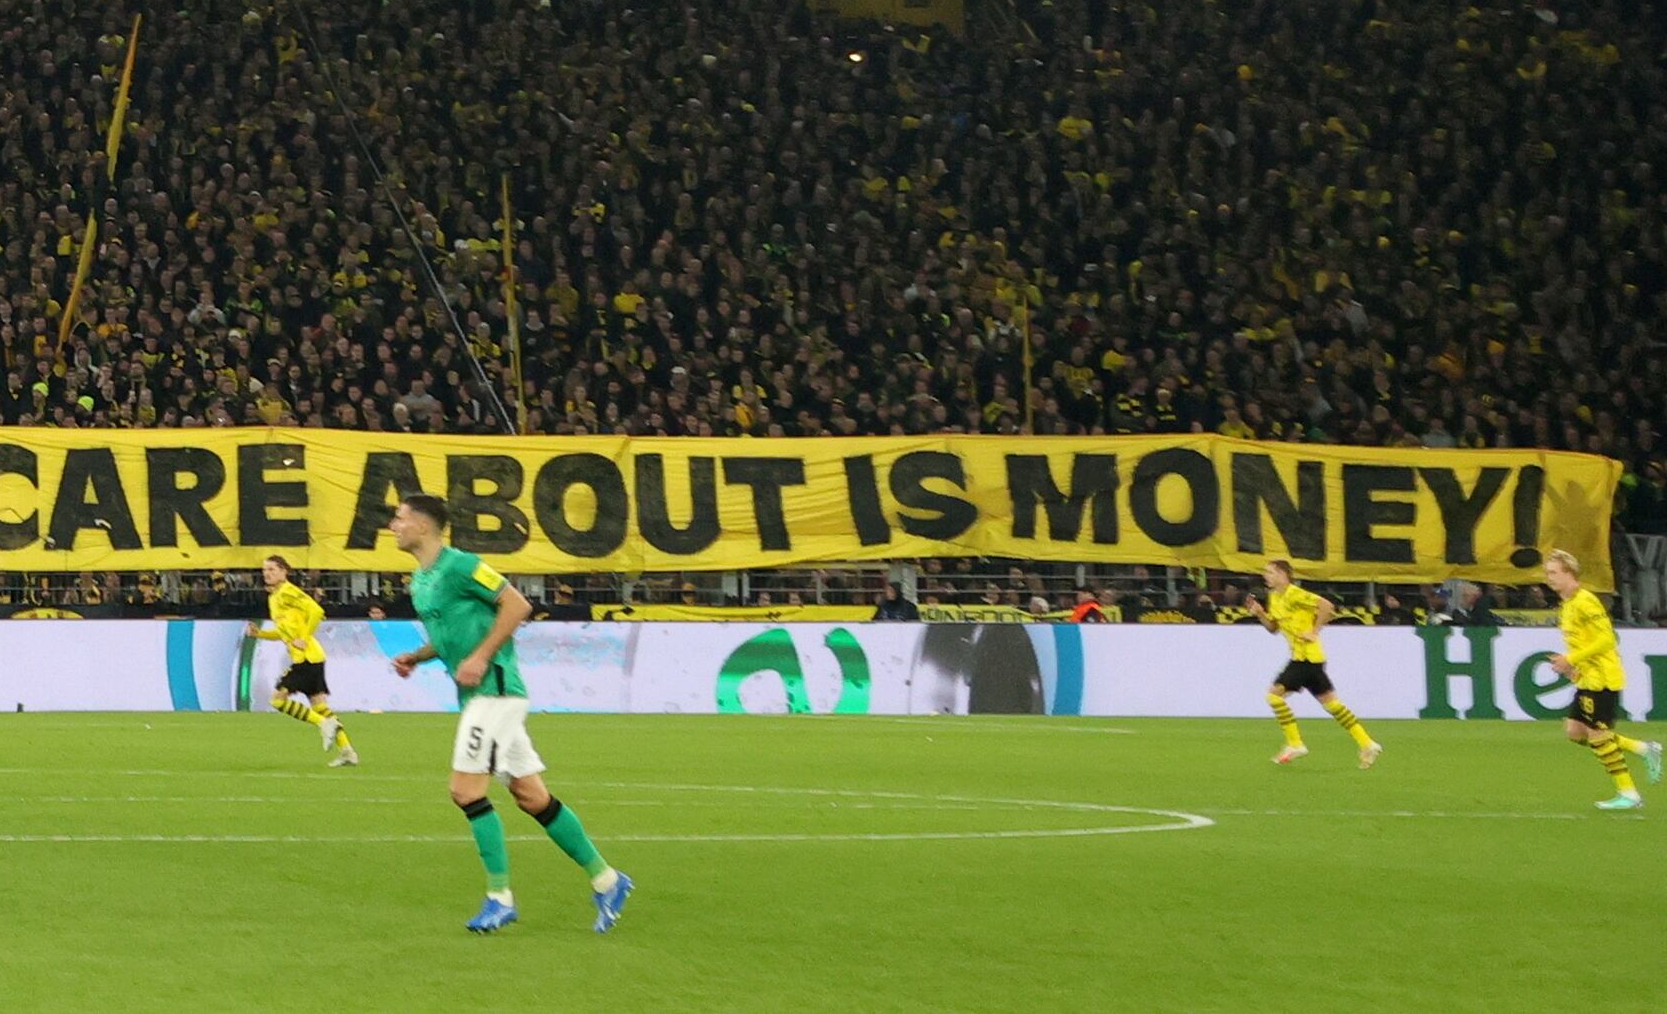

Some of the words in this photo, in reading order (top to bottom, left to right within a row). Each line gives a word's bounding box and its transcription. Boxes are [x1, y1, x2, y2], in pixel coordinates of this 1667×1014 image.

[346, 452, 808, 559] ABOUT
[843, 450, 978, 547] IS
[1003, 446, 1547, 567] MONEY!
[466, 726, 483, 750] 5
